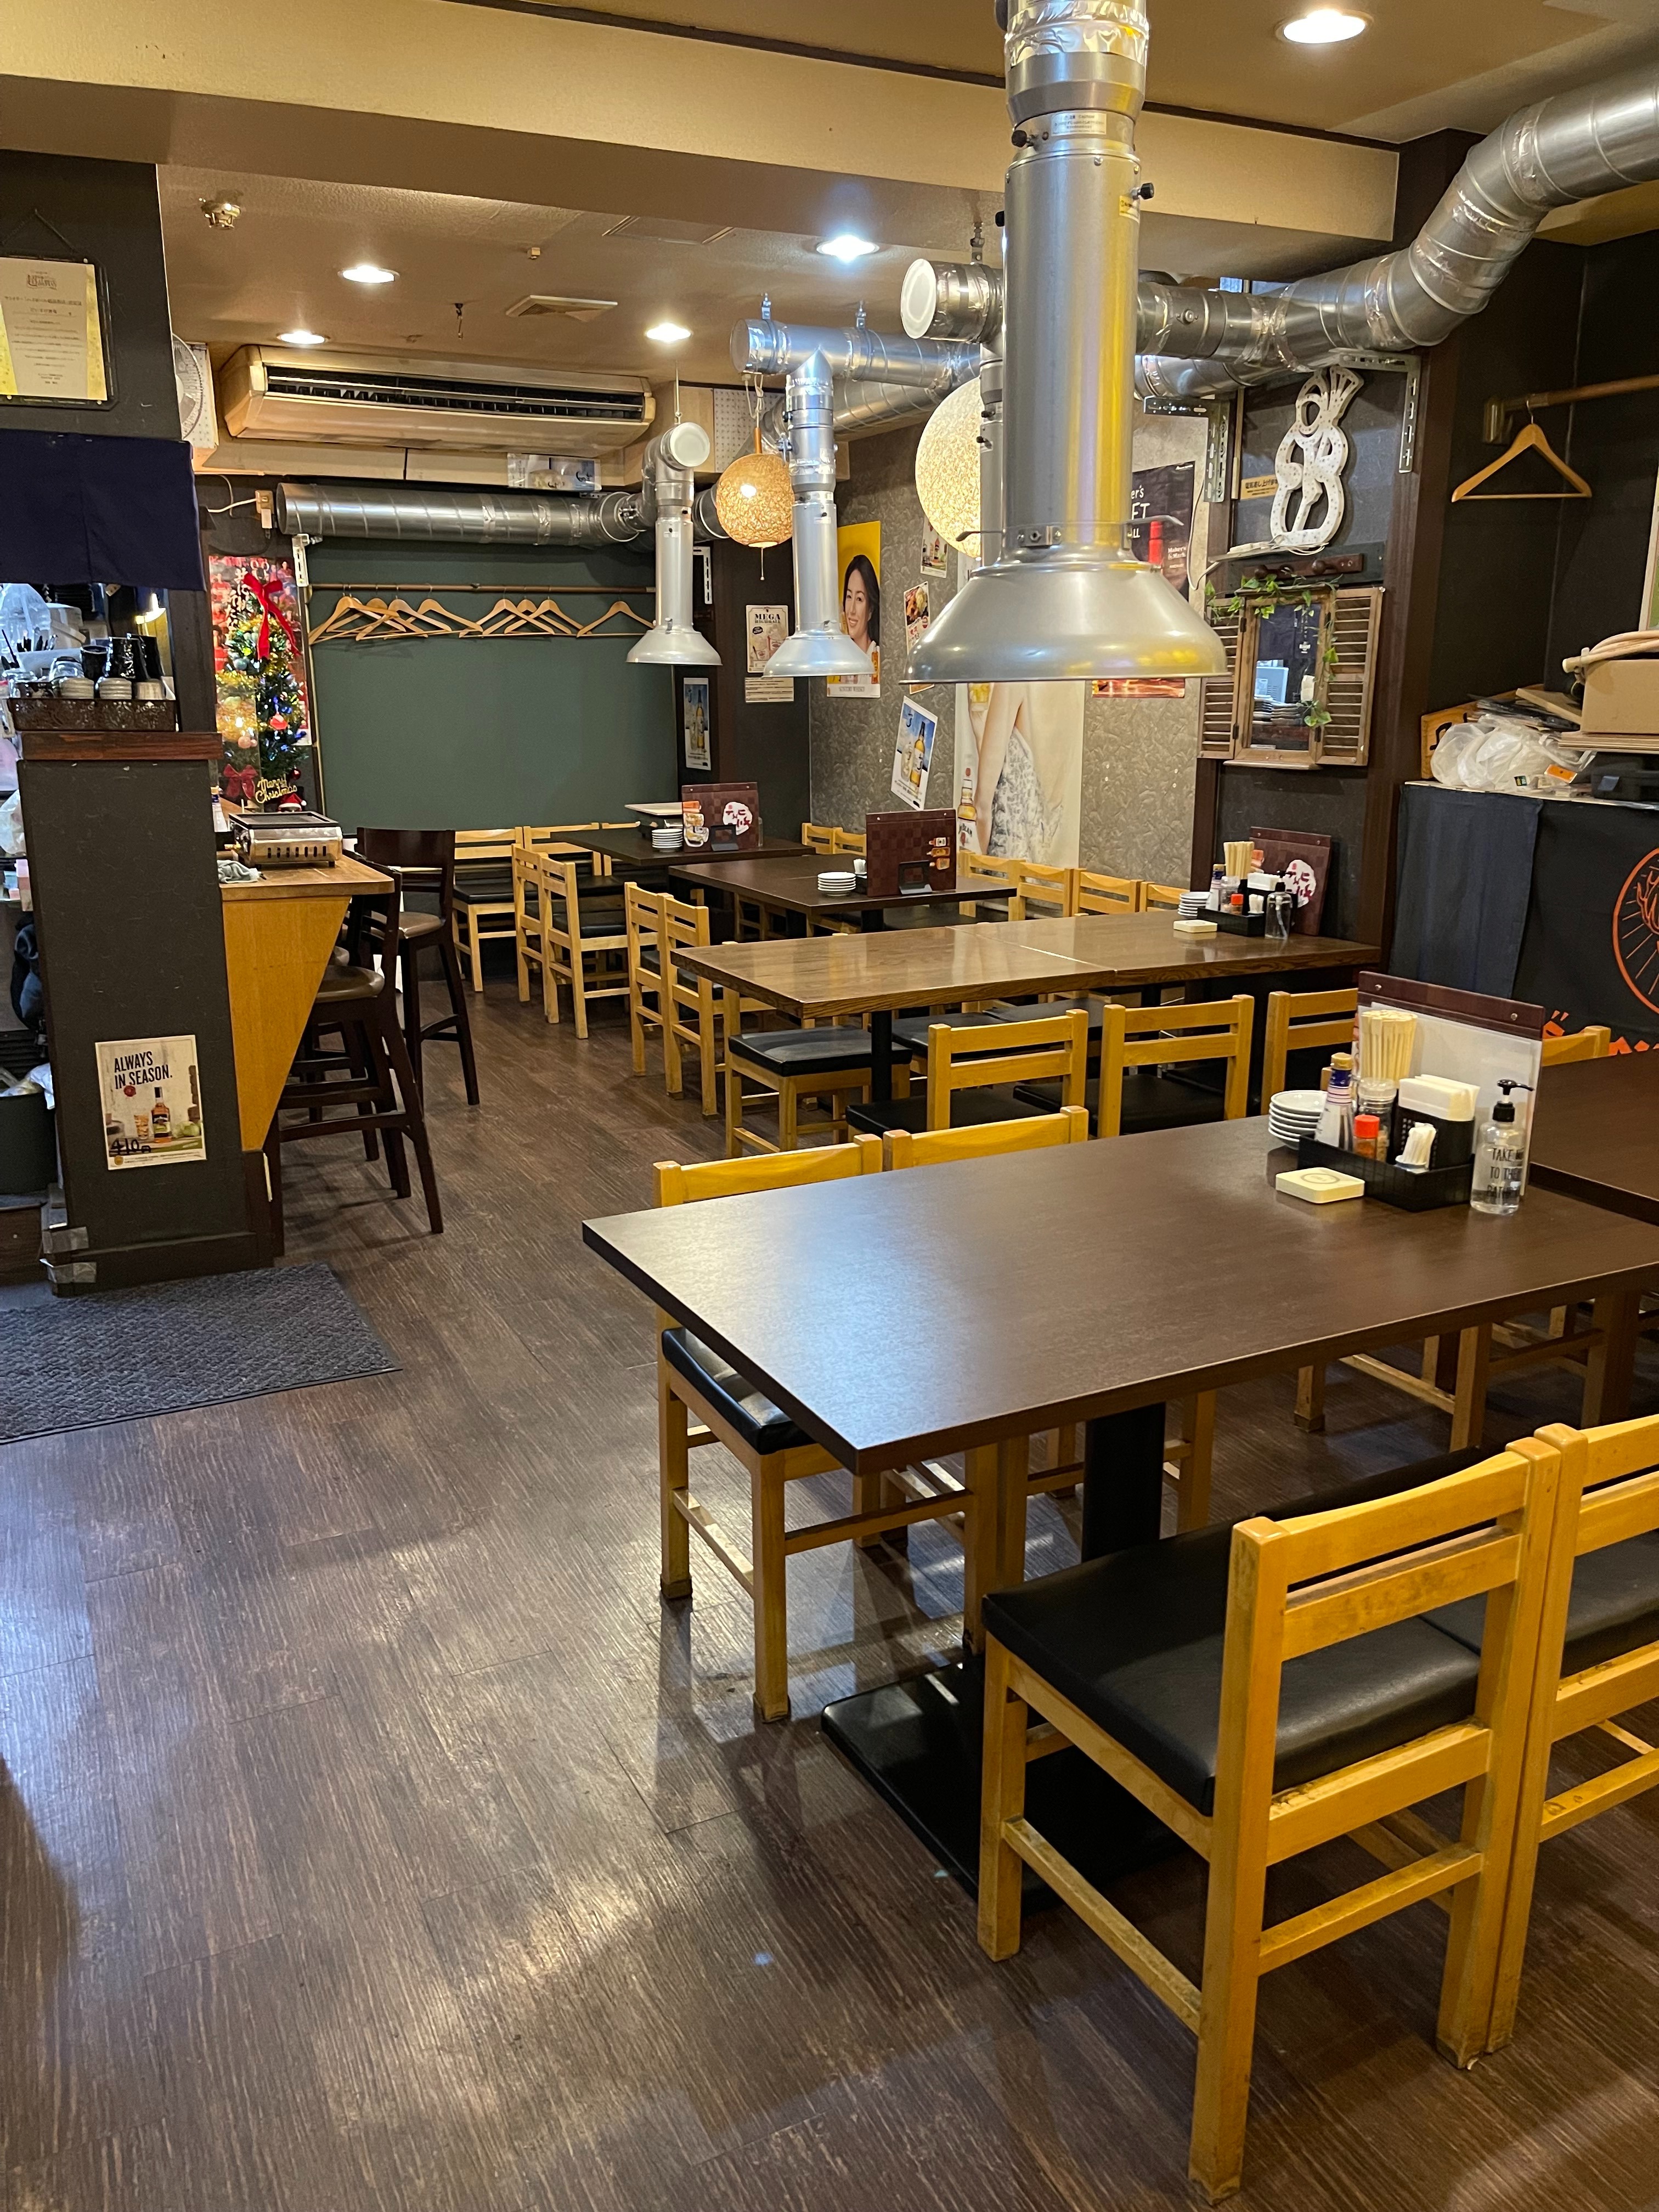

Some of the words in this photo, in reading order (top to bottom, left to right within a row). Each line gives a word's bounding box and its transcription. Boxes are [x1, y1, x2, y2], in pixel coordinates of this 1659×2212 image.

[1131, 485, 1144, 499] er's
[1131, 502, 1150, 520] FT
[255, 783, 297, 804] Christmas
[114, 1051, 153, 1073] ALWAYS
[114, 1073, 126, 1090] IN
[128, 1064, 173, 1086] SEASON.
[1490, 1166, 1500, 1179] TO
